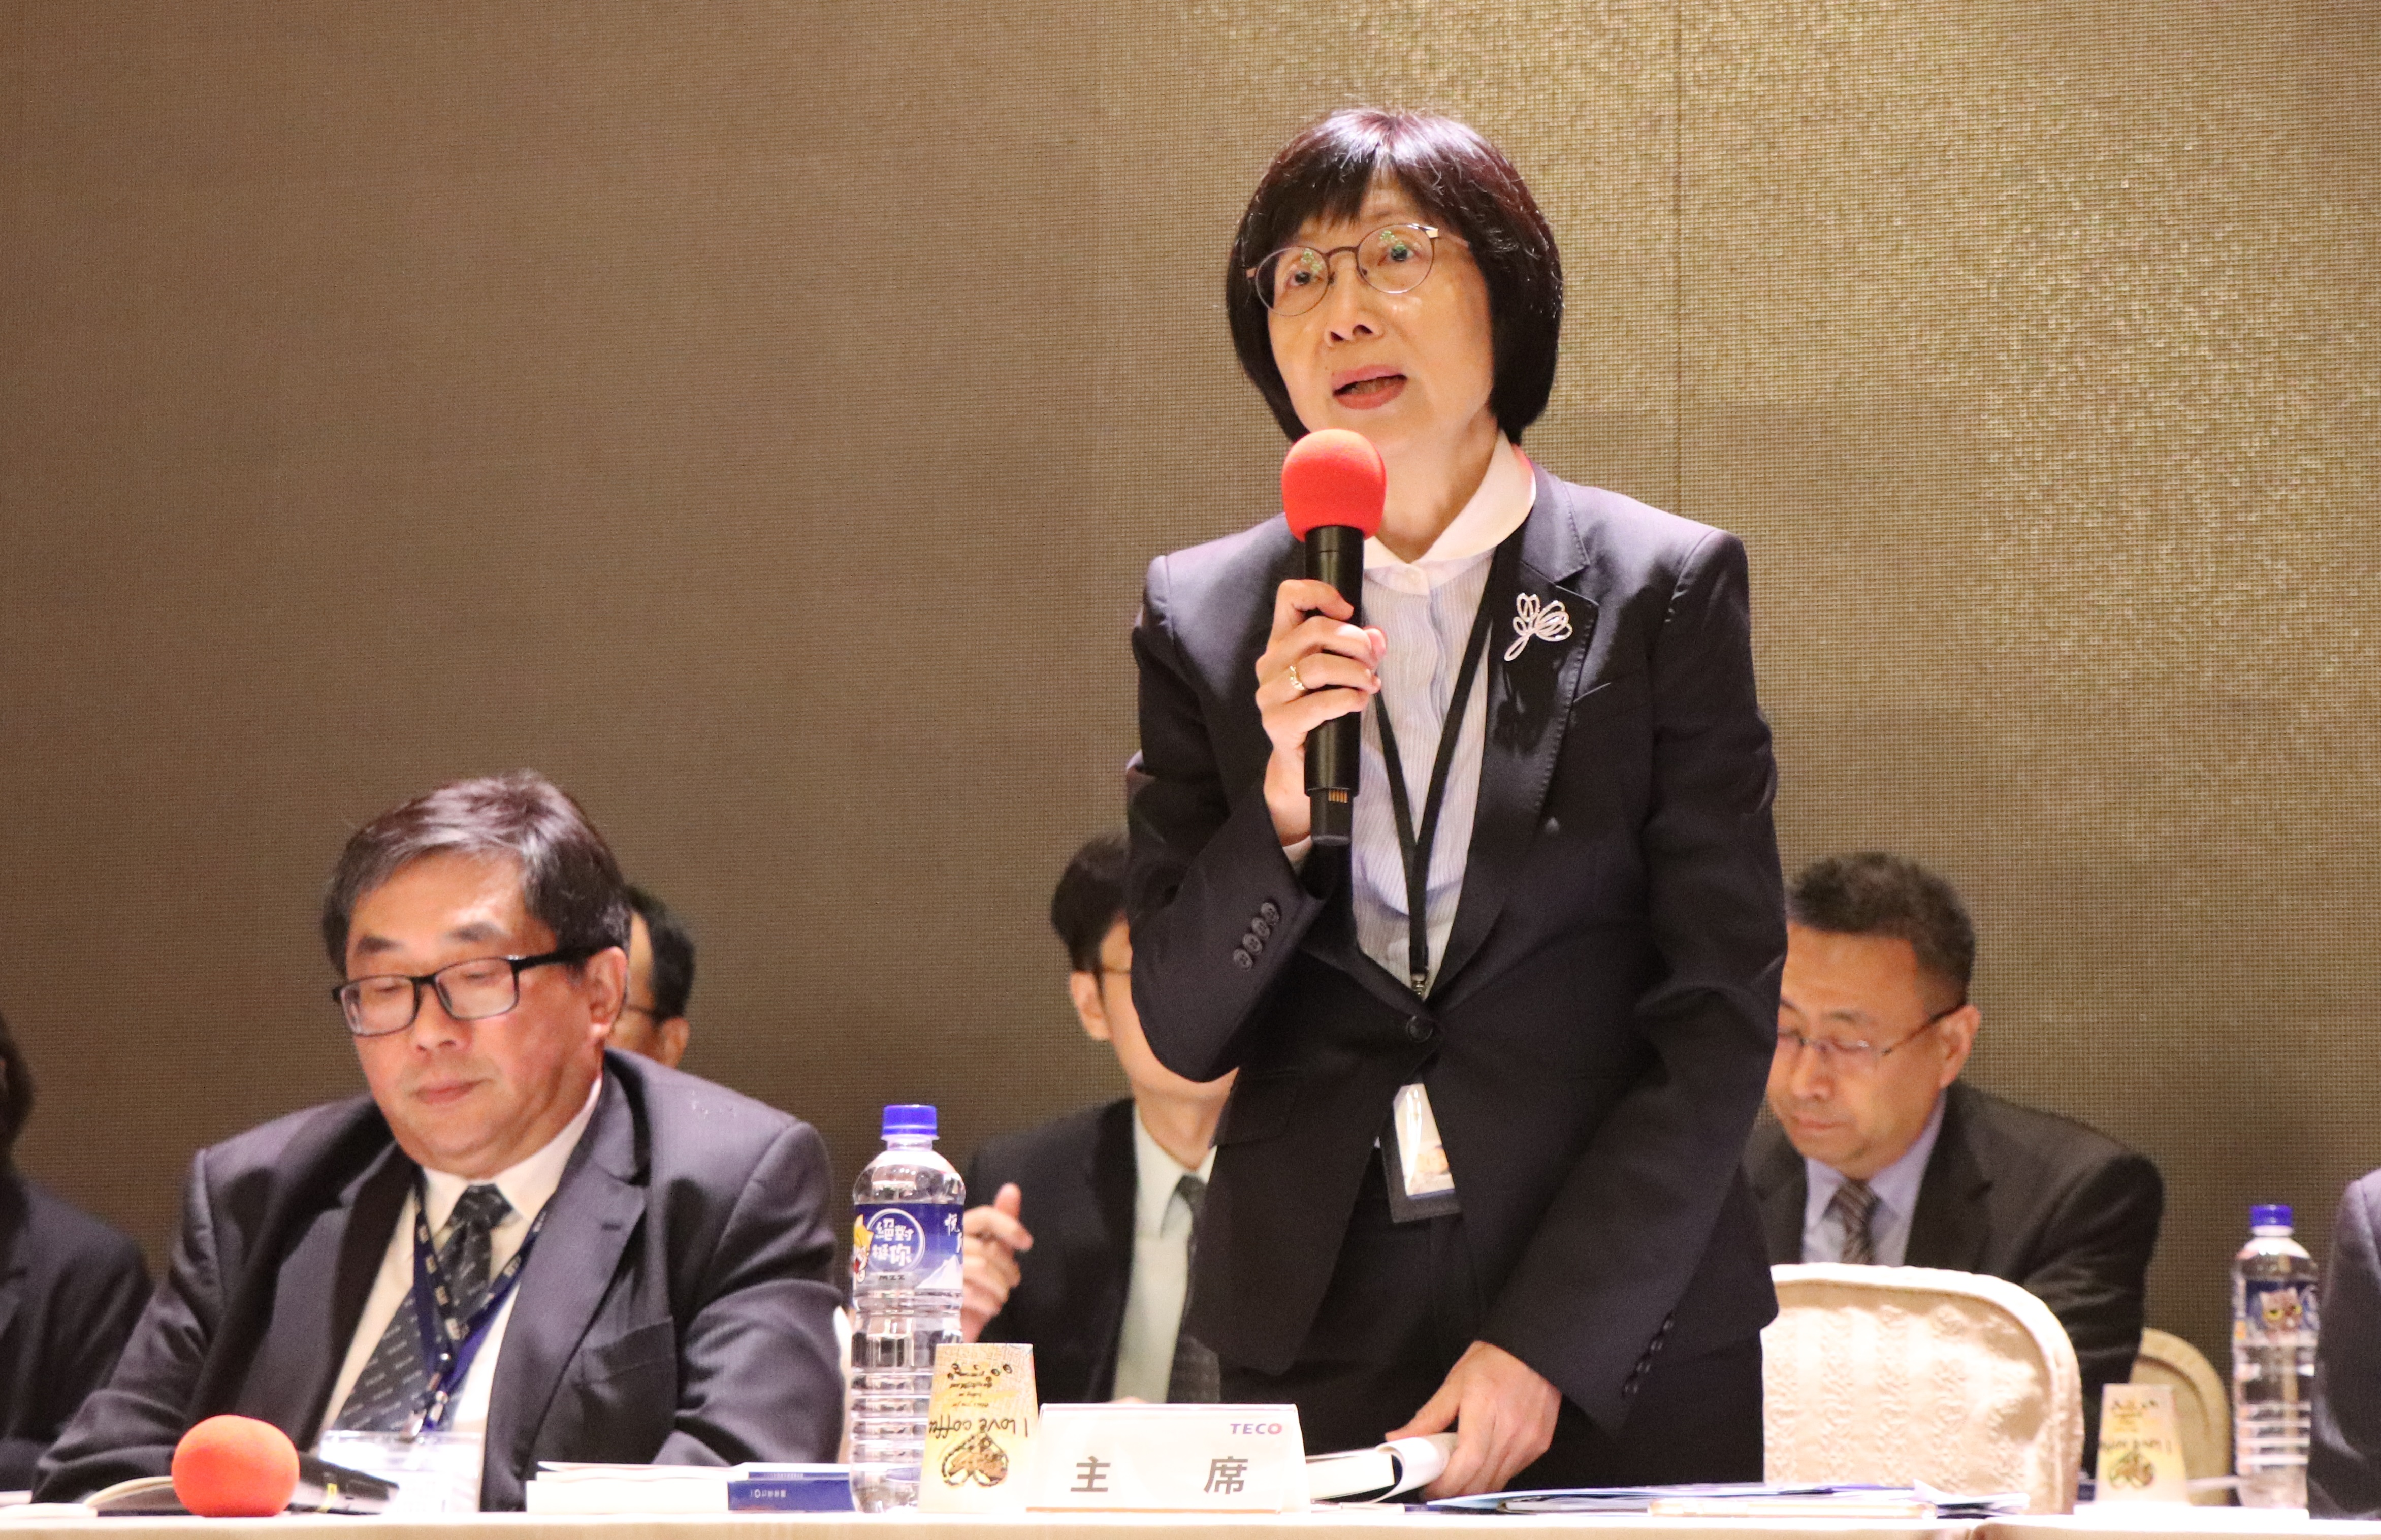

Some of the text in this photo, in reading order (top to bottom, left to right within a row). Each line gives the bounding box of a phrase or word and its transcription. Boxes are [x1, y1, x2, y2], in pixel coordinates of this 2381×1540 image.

[875, 1218, 914, 1241] 絕對
[872, 1243, 912, 1266] 挺你
[1230, 1423, 1283, 1435] TECO
